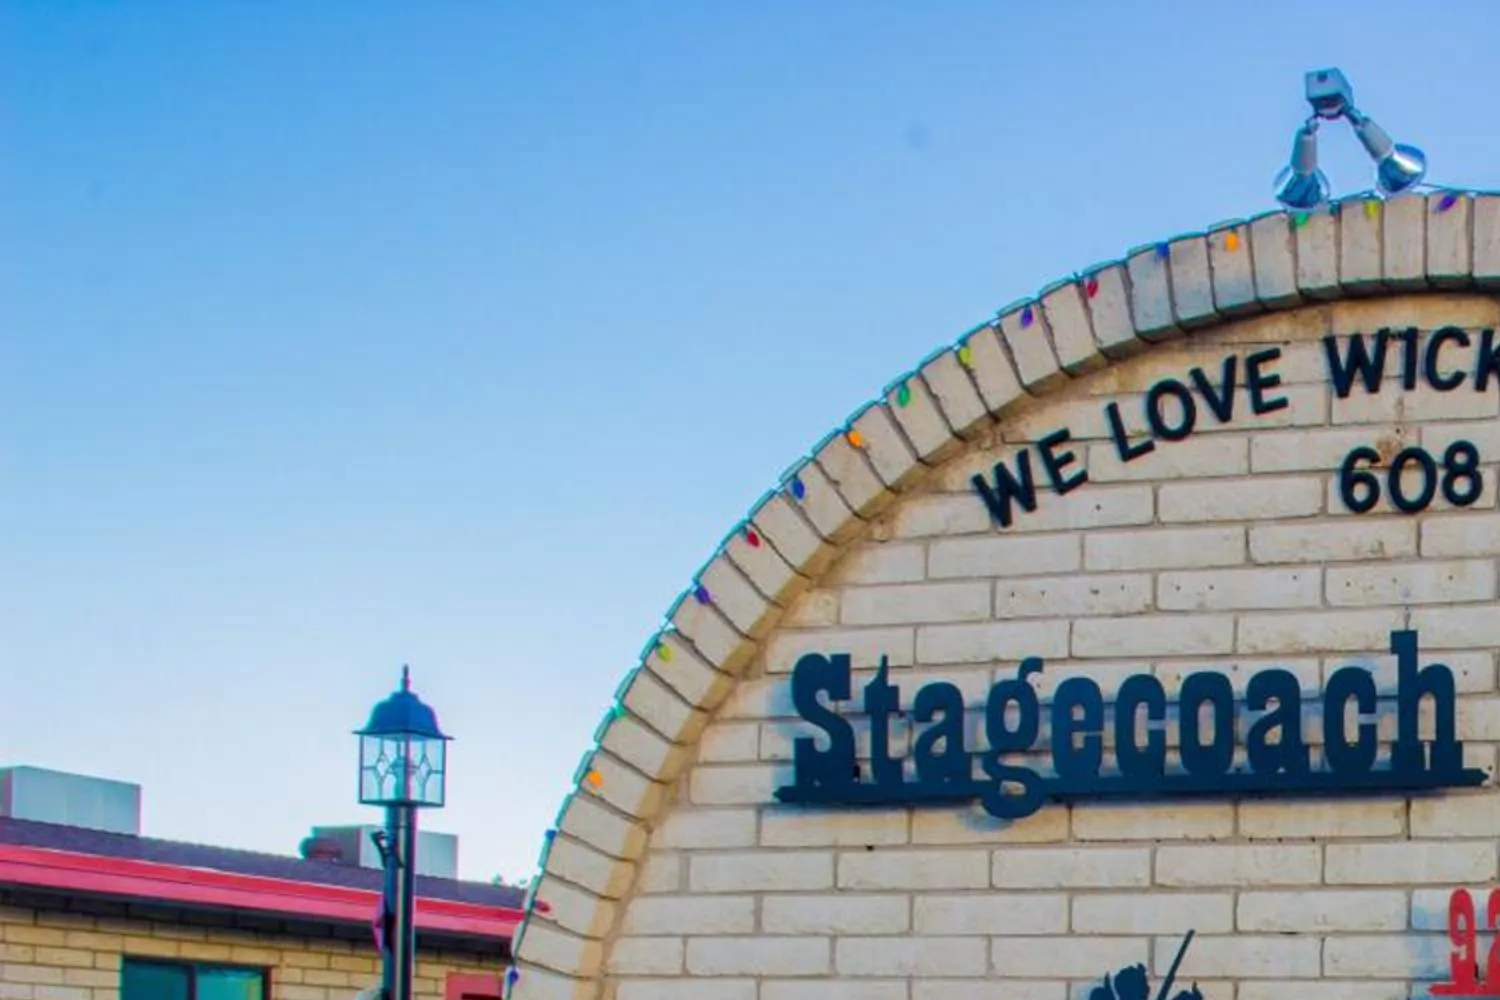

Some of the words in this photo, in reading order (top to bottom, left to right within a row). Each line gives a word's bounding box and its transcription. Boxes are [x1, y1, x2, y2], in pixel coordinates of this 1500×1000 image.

[971, 427, 1089, 529] WE
[1105, 346, 1289, 463] LOVE
[1340, 440, 1484, 515] 608
[790, 629, 1466, 818] Stagecoach
